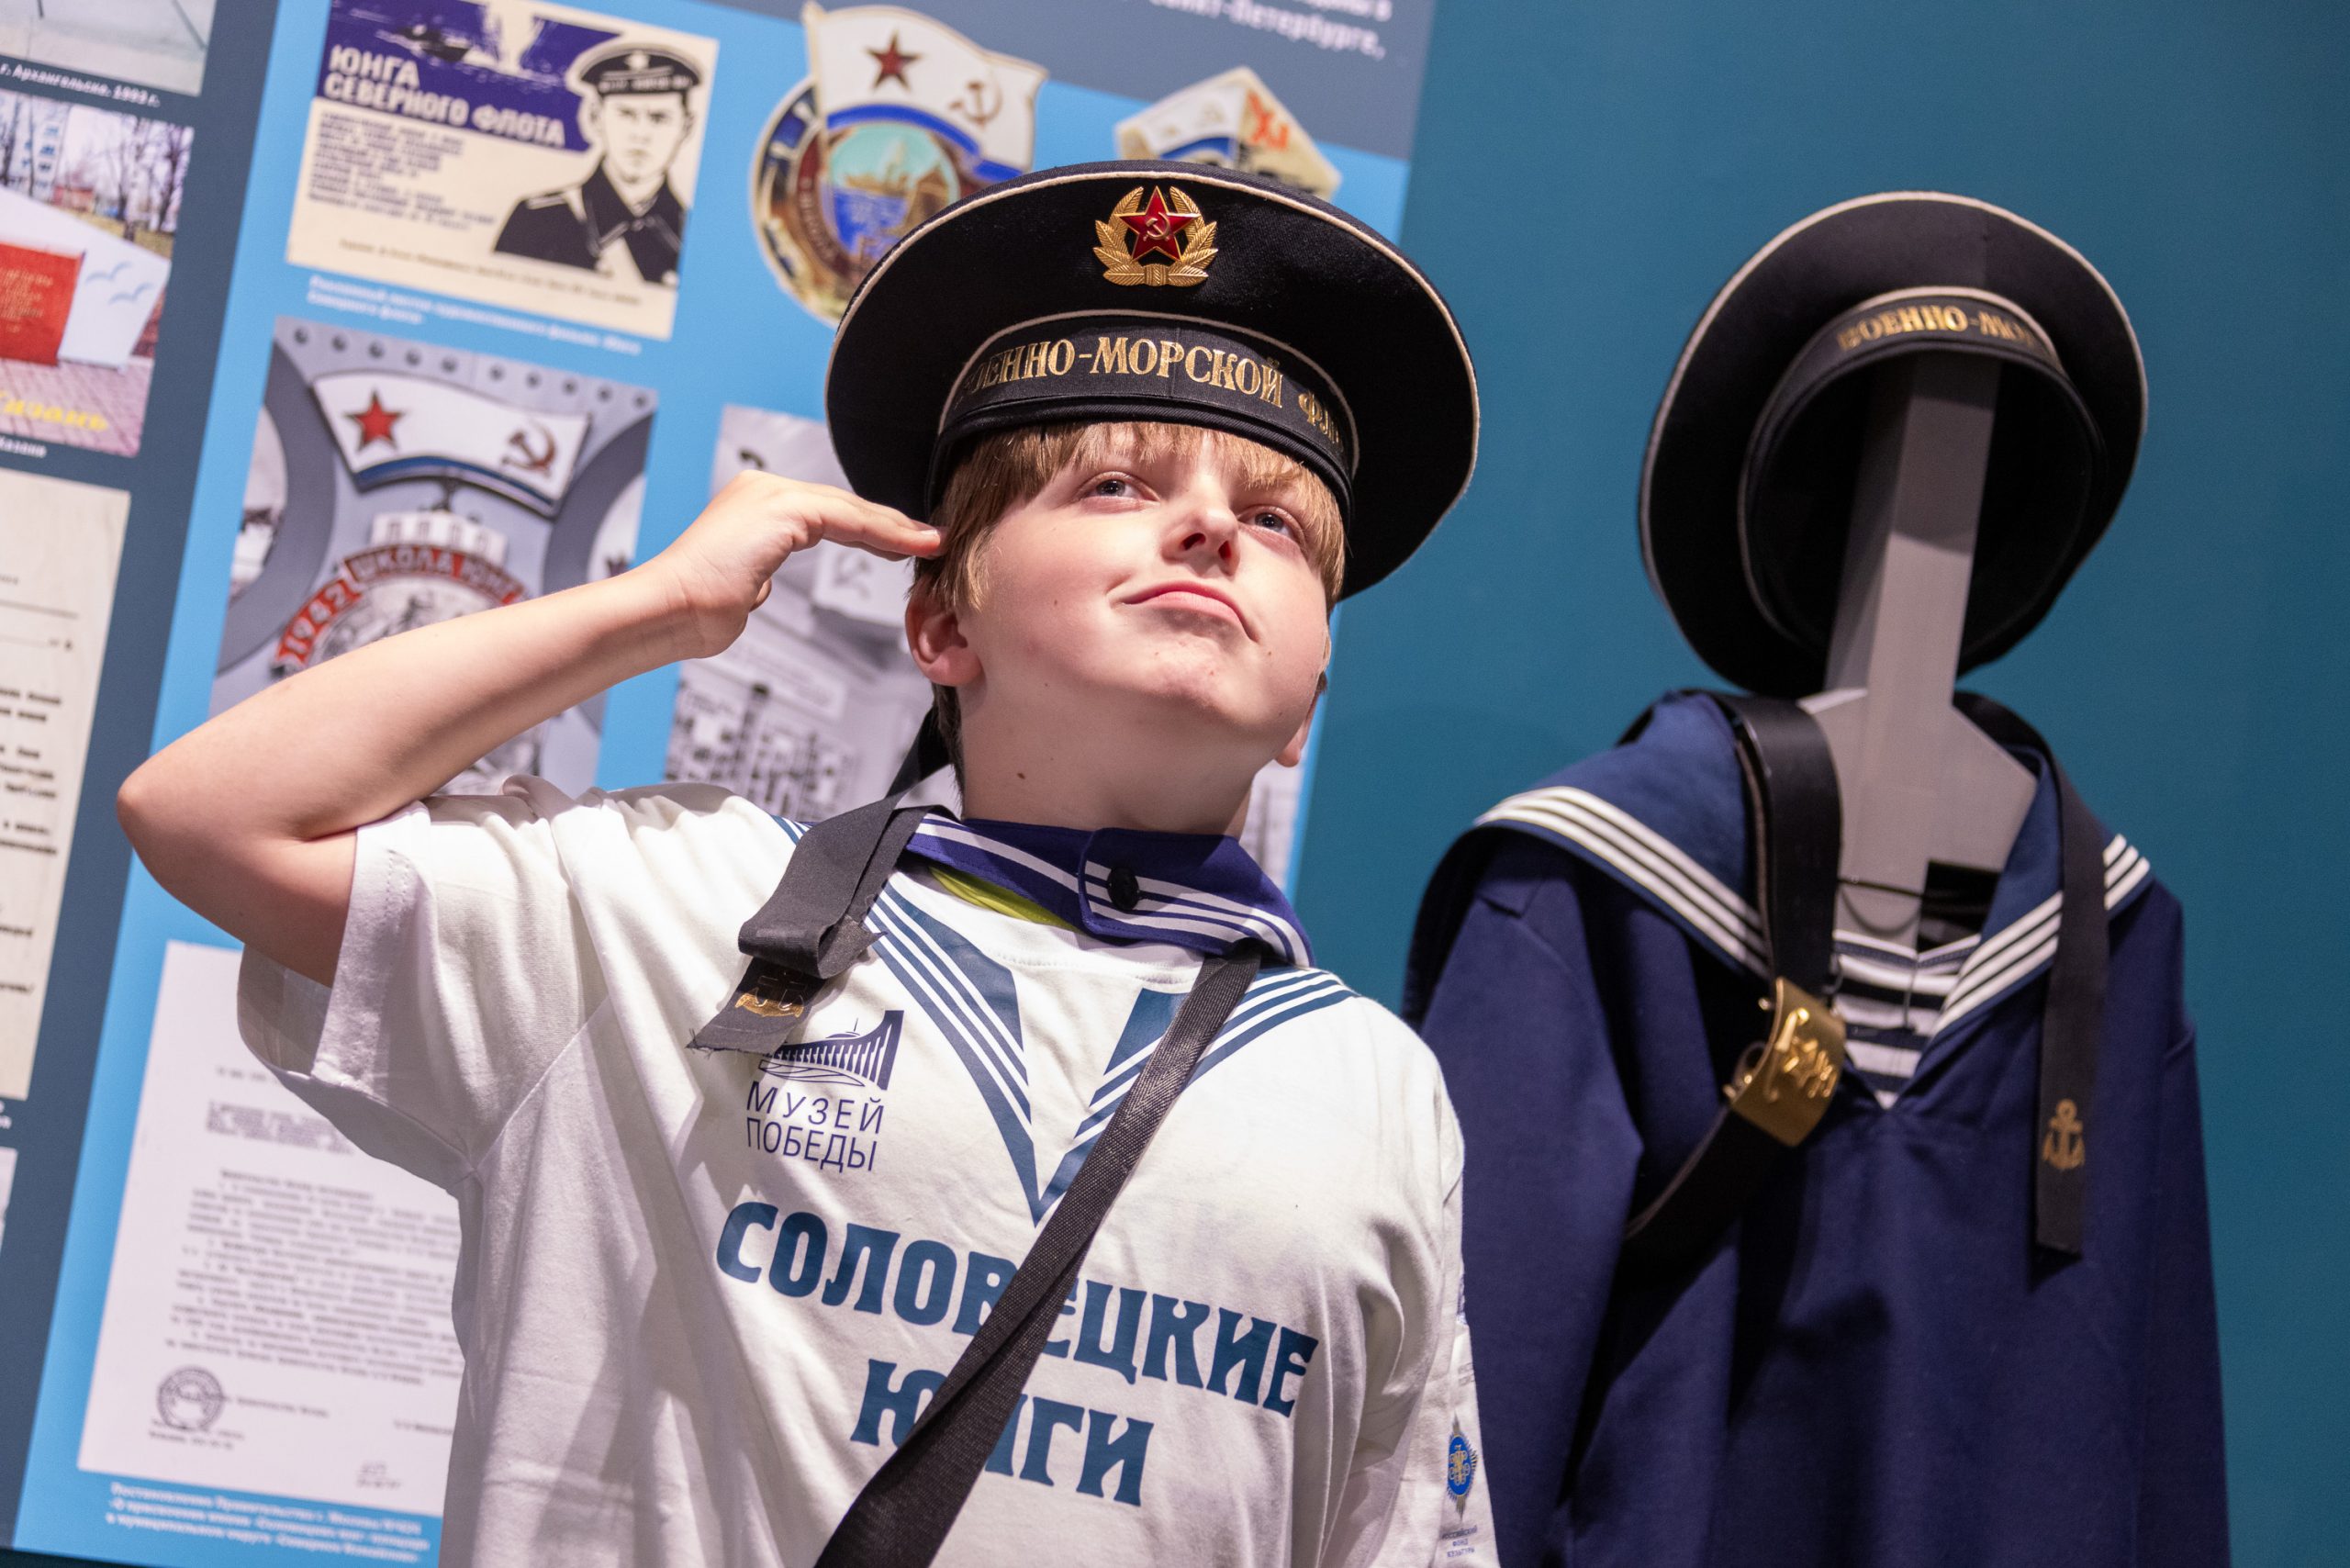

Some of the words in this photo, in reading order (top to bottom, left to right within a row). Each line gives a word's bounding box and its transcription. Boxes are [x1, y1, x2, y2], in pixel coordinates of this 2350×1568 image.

[328, 44, 420, 89] ЮНГА
[324, 73, 470, 127] СЕВЕРНОГО
[471, 104, 566, 148] ФЛОТА
[746, 1081, 884, 1134] МУЗЕЙ
[746, 1117, 877, 1173] ПОБЕДЫ
